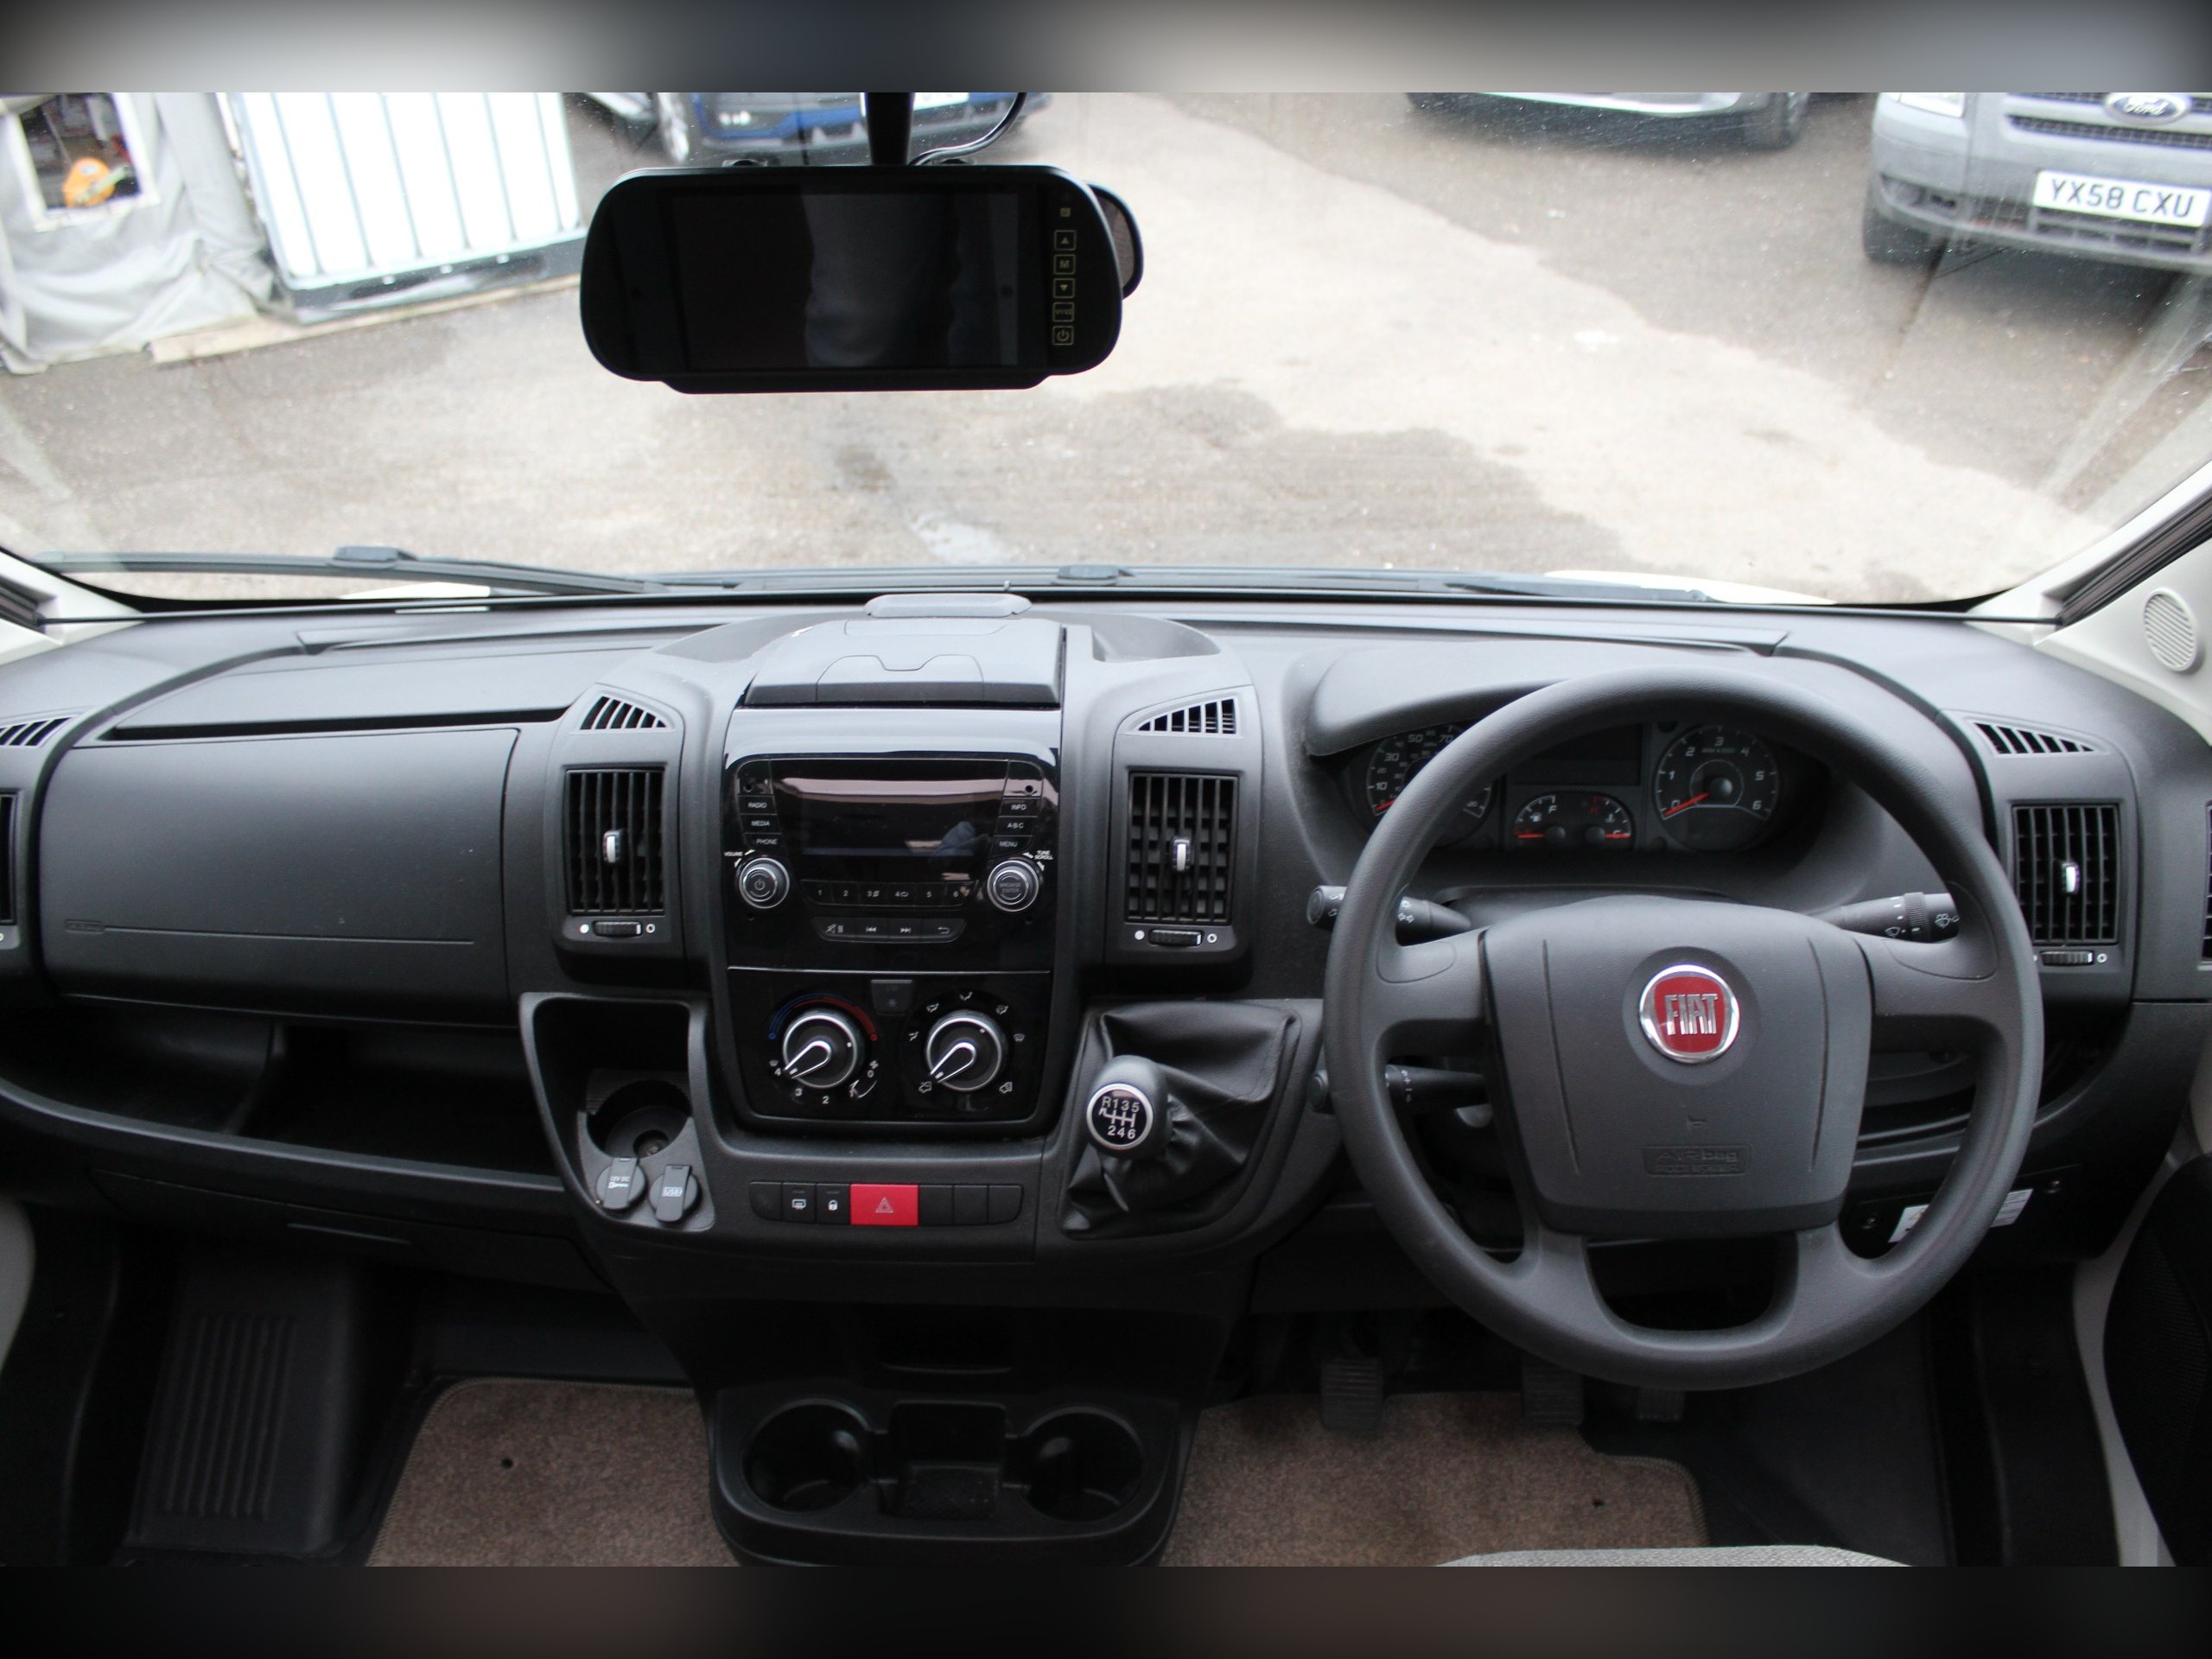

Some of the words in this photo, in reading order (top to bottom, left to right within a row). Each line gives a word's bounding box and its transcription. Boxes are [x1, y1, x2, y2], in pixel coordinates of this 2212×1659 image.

[2122, 94, 2171, 117] Ford
[2050, 177, 2126, 210] YX58
[2132, 189, 2196, 219] CXU
[1408, 734, 1424, 743] 50
[1715, 737, 1725, 747] 3
[1686, 747, 1695, 757] 2
[1741, 747, 1749, 757] 4
[1384, 753, 1400, 762] 30
[1669, 771, 1675, 780] 1
[1756, 771, 1765, 781] 5
[1376, 781, 1388, 791] 10
[1549, 804, 1558, 814] F
[1753, 801, 1762, 810] 6
[1664, 993, 1719, 1036] FIAT
[774, 1067, 781, 1077] 4
[795, 1088, 803, 1097] 3
[822, 1096, 830, 1104] 2
[1102, 1096, 1112, 1108] R
[1112, 1098, 1119, 1109] 1
[1122, 1100, 1130, 1111] 3
[1132, 1103, 1141, 1113] 5
[1108, 1126, 1116, 1136] 2
[1117, 1128, 1126, 1138] 4
[1128, 1129, 1137, 1140] 6
